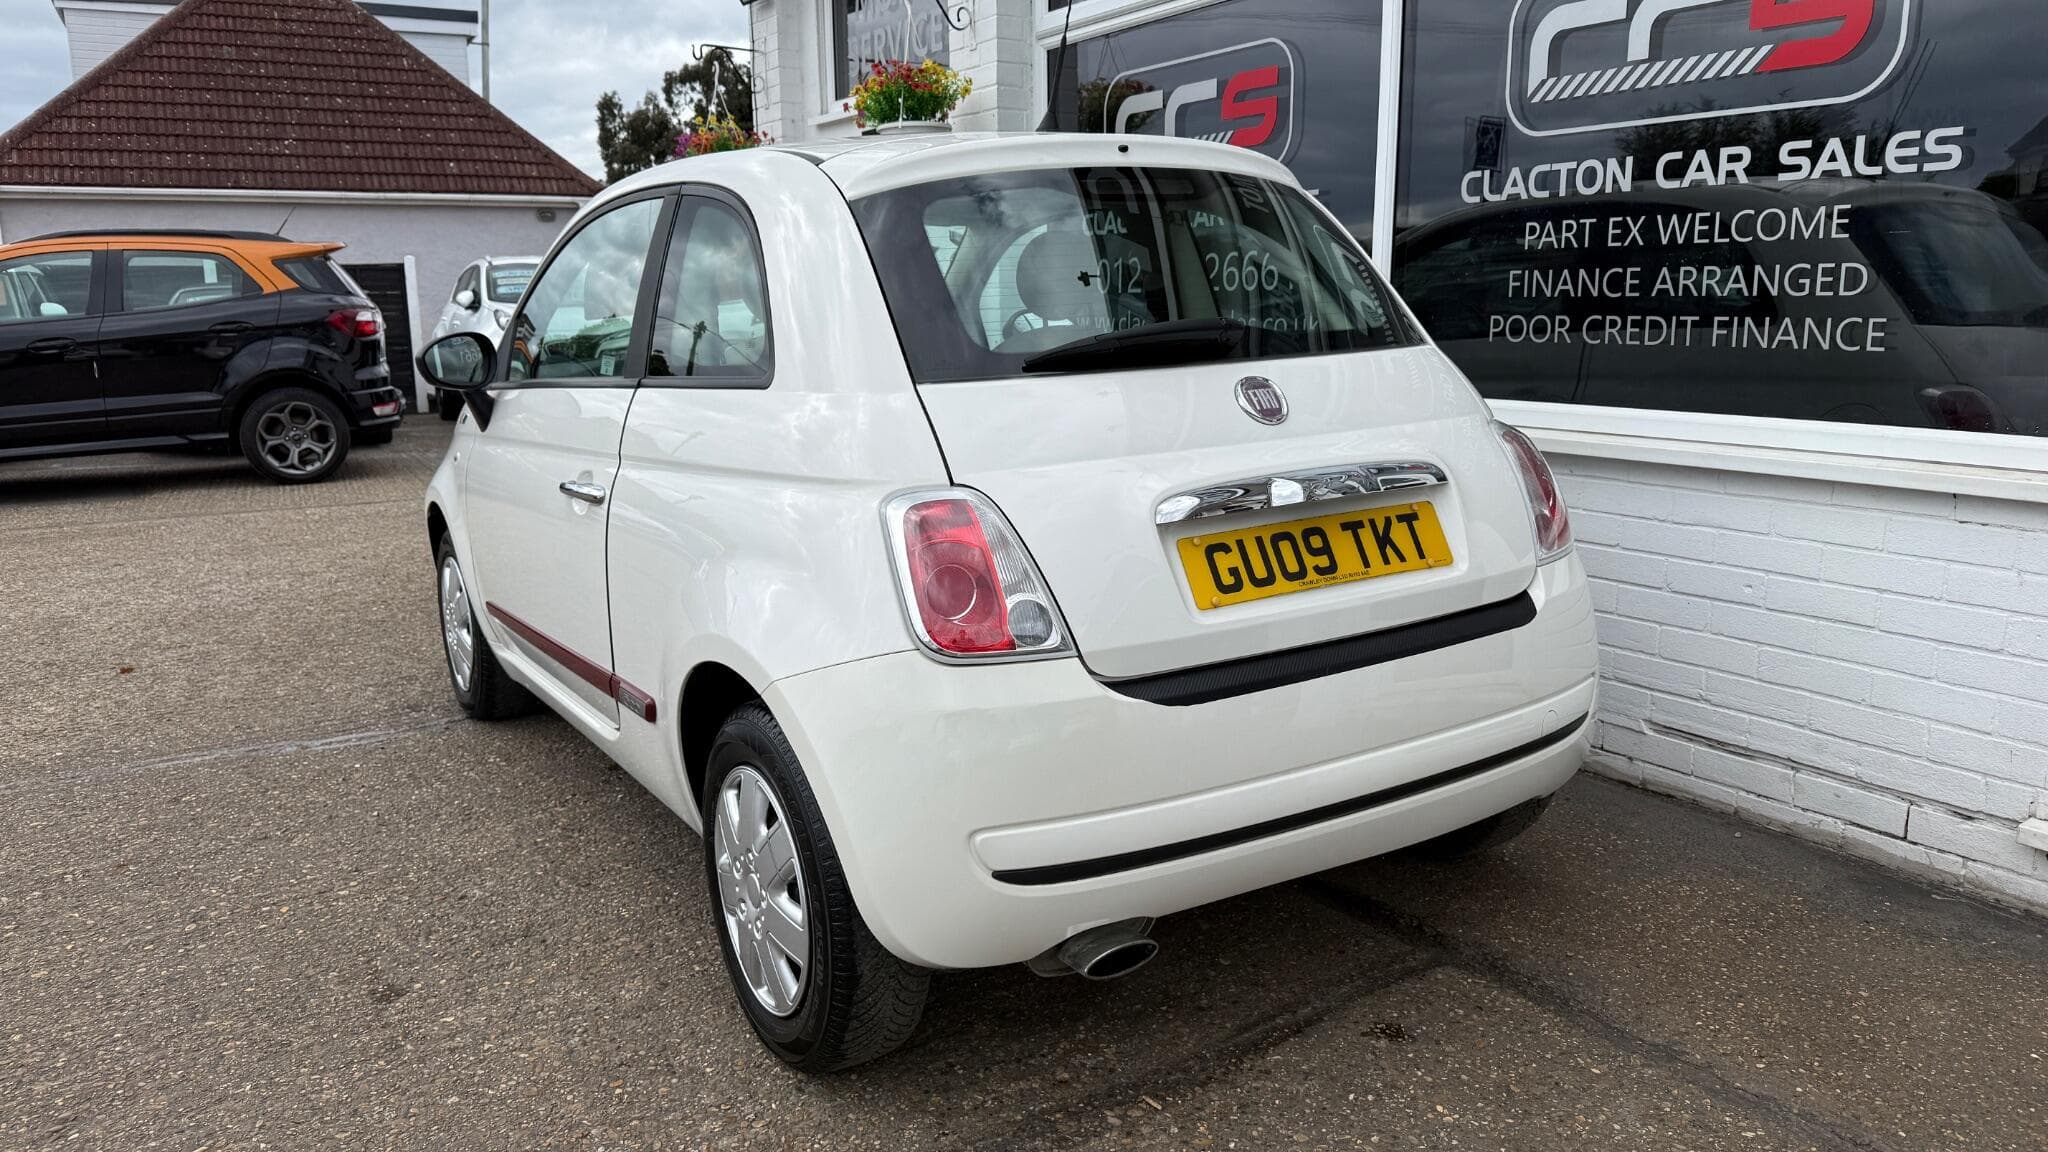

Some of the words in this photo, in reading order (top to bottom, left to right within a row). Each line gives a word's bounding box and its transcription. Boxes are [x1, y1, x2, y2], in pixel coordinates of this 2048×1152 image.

[1461, 156, 1634, 204] CLACTON
[1655, 145, 1752, 189] CAR
[1777, 126, 1964, 182] SALES
[1524, 218, 1597, 250] PART
[1607, 216, 1645, 247] EX
[1656, 204, 1852, 245] WELCOME
[1508, 267, 1641, 298] FINANCE
[1651, 262, 1869, 297] ARRANGED
[1489, 315, 1571, 343] POOR
[1582, 315, 1700, 346] CREDIT
[1712, 316, 1888, 352] FINANCE
[1246, 388, 1280, 410] FIAT
[1204, 526, 1339, 595] GU09
[1339, 511, 1427, 569] TKT
